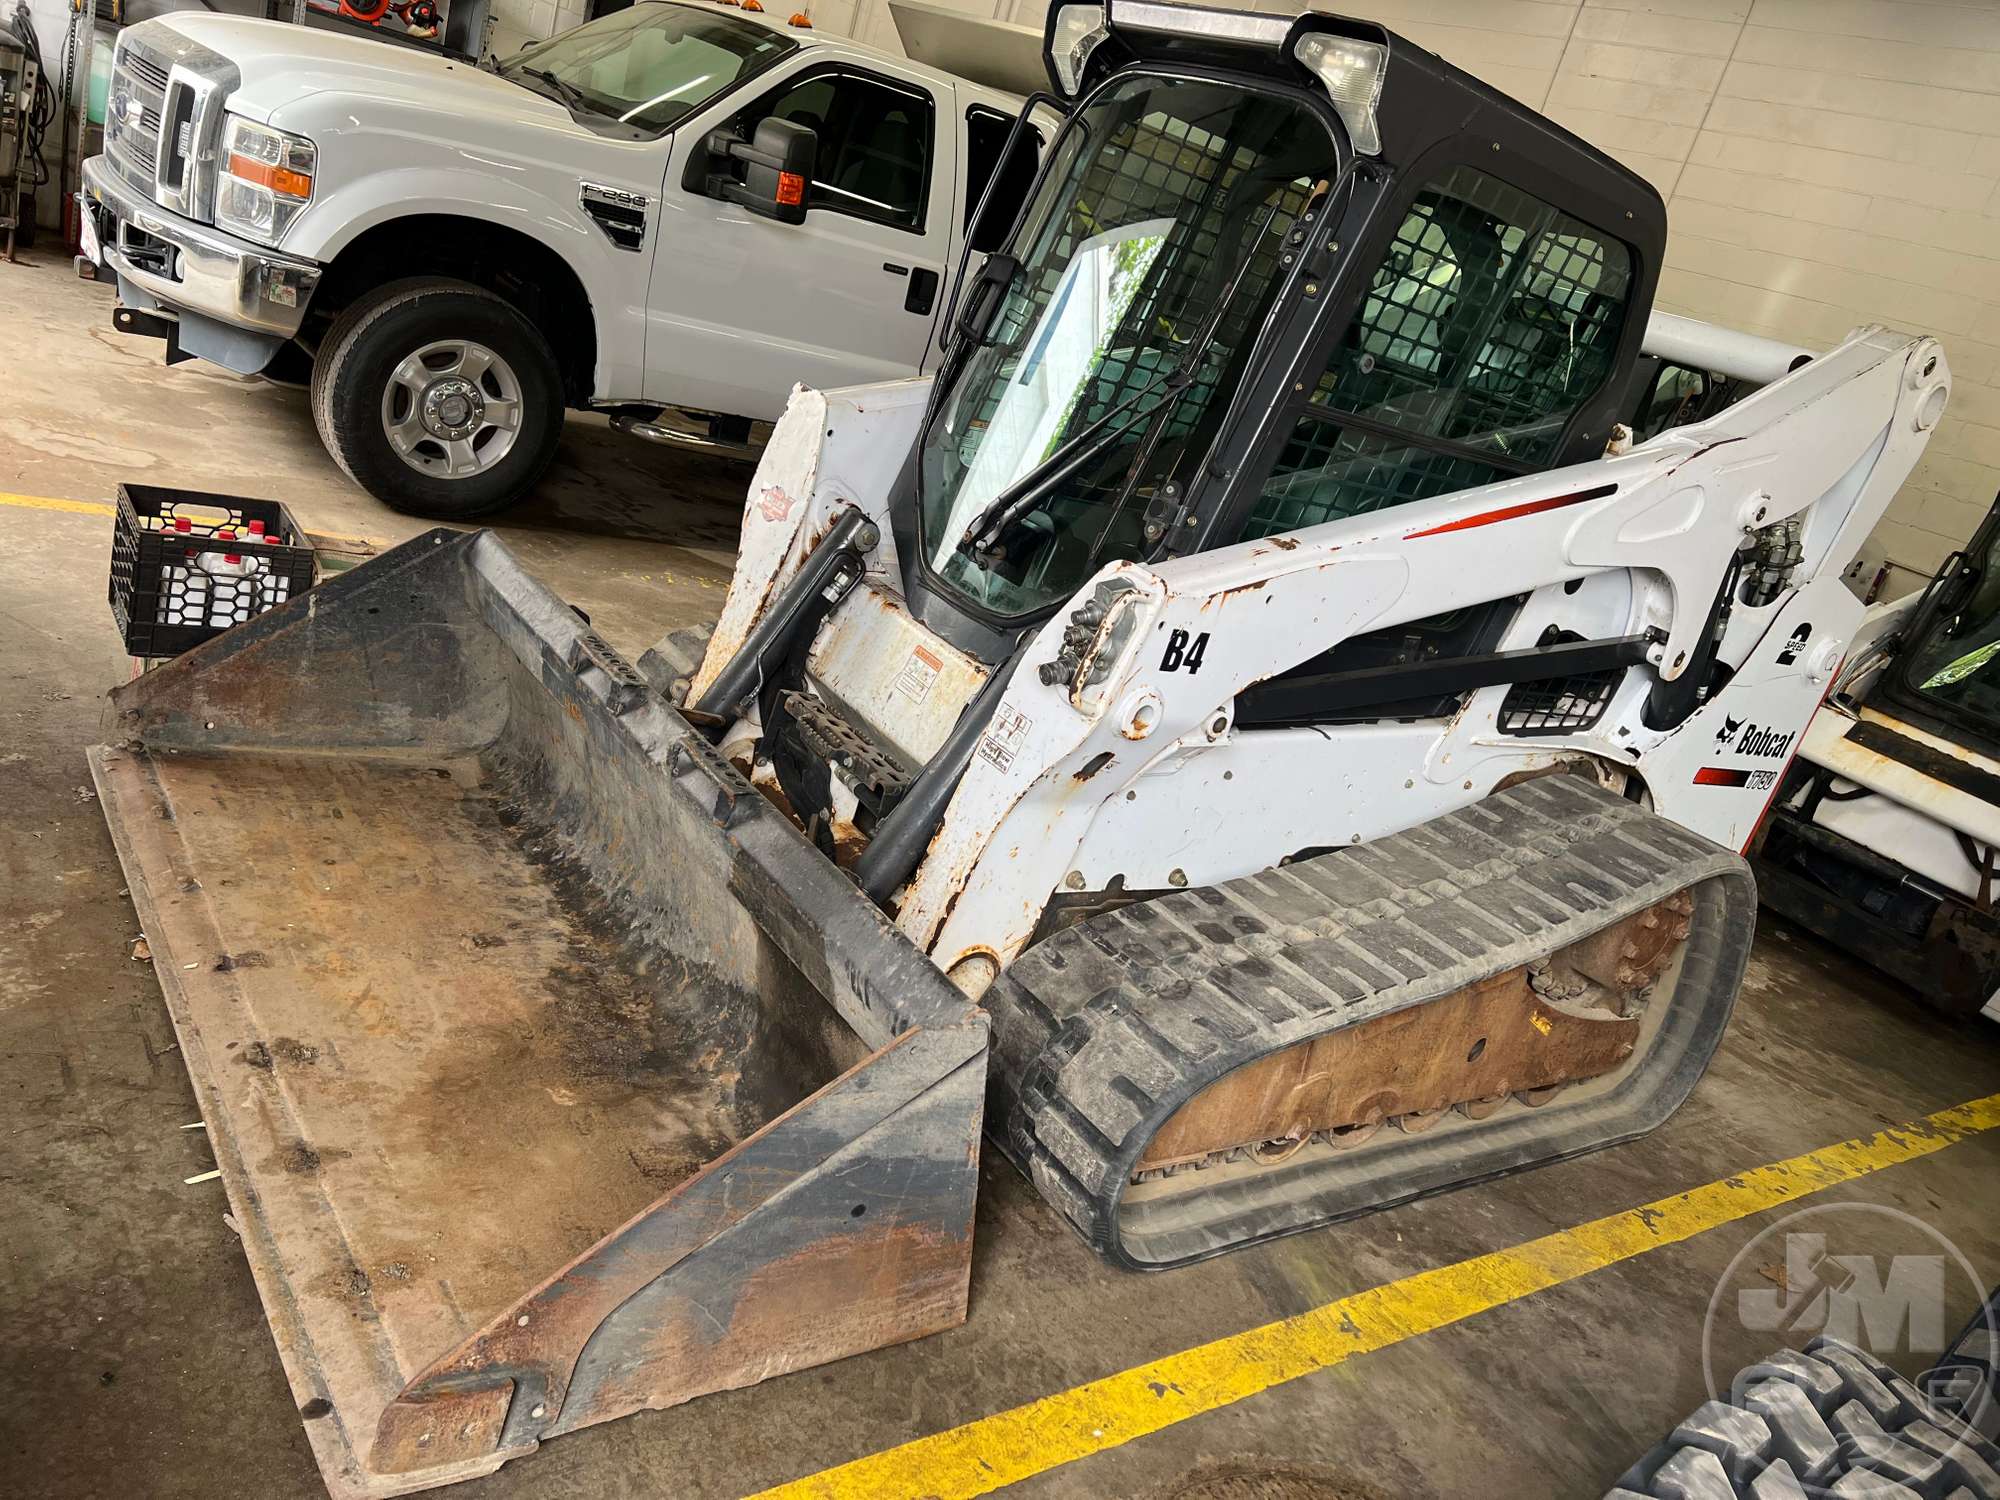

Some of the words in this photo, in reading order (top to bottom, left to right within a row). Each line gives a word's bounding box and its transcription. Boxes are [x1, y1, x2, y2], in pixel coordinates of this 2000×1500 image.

[1159, 628, 1211, 675] B4
[1784, 640, 1807, 652] SPEED
[1735, 723, 1796, 759] Bobcat
